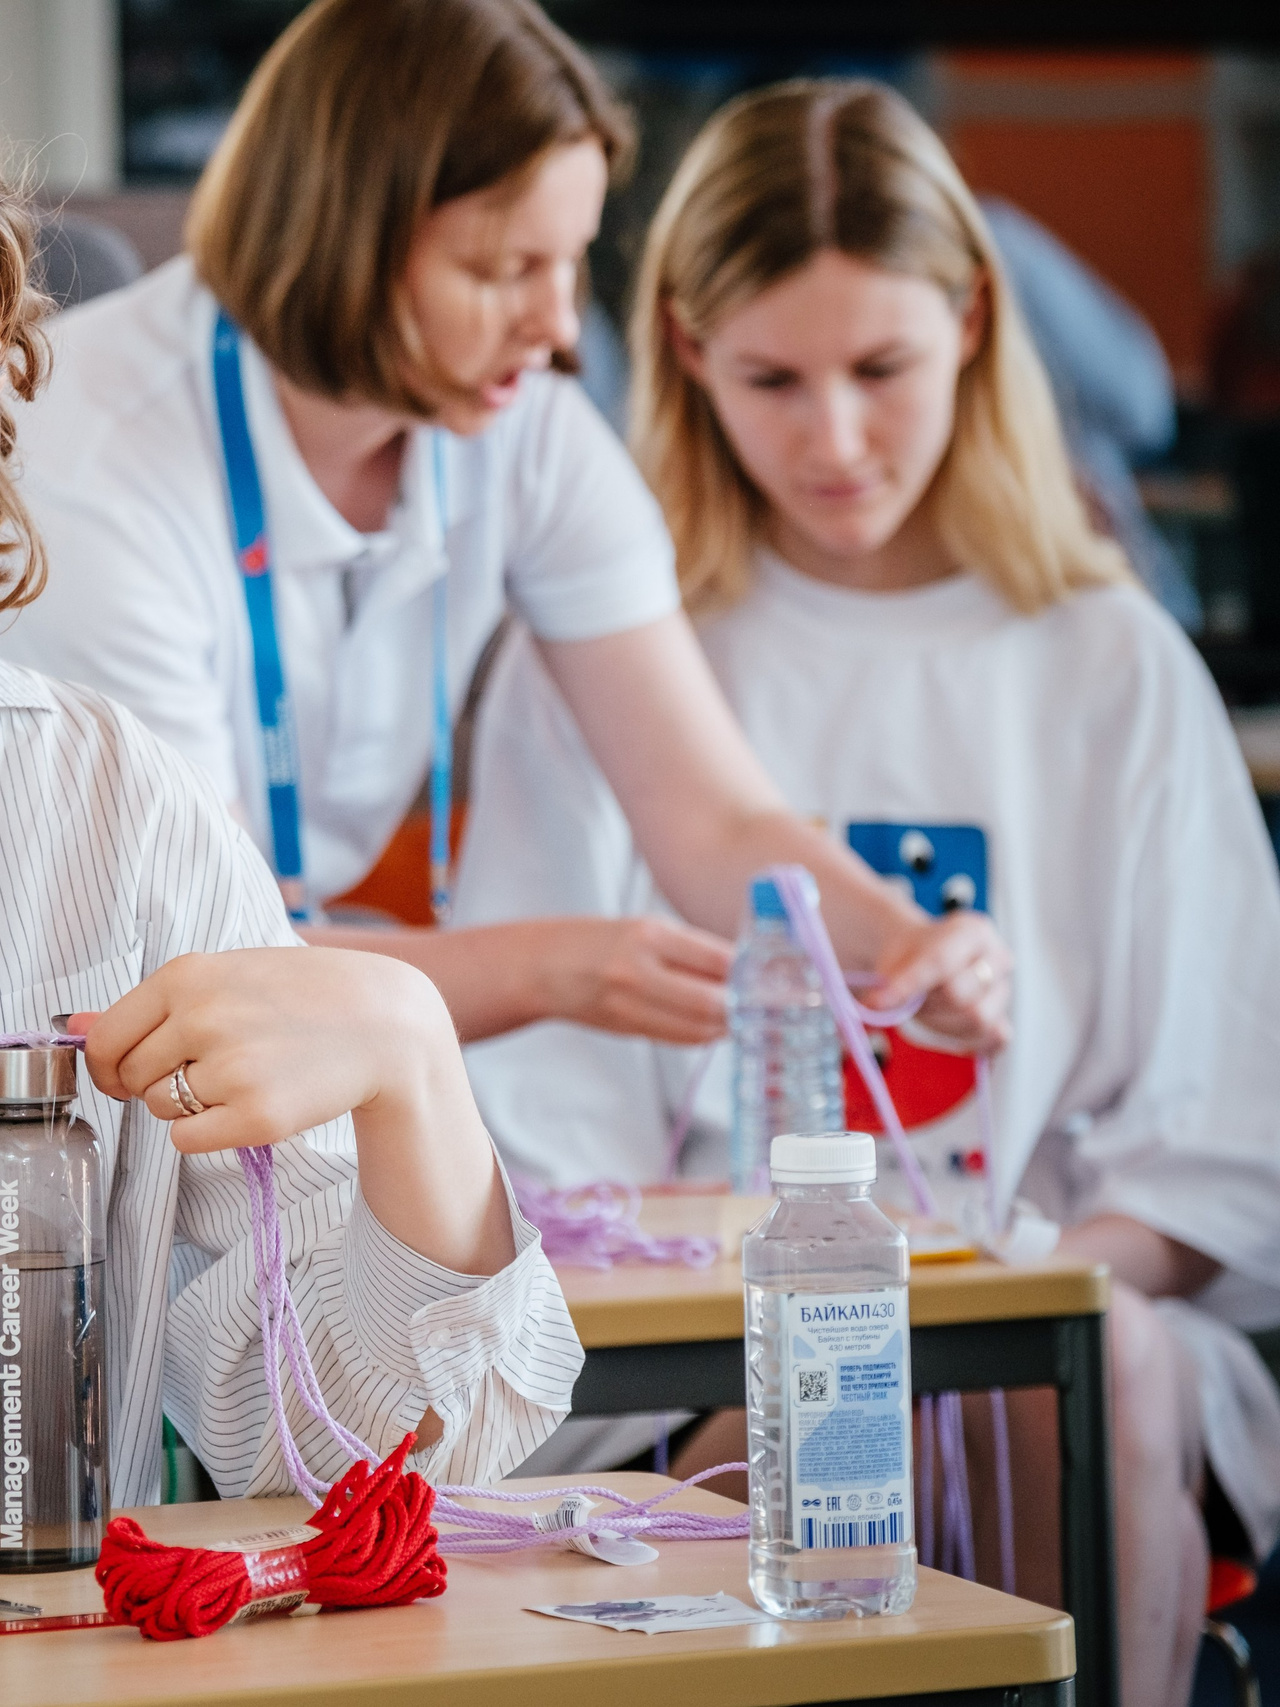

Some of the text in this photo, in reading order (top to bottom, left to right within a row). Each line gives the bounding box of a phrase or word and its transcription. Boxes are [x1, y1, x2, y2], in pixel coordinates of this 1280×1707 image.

[808, 1324, 889, 1334] Чистейшая вода озера
[817, 1335, 845, 1343] Байкал
[852, 1334, 880, 1342] глубины
[829, 1344, 871, 1352] 430 метров
[0, 1364, 30, 1549] Management
[857, 1513, 882, 1521] 850450
